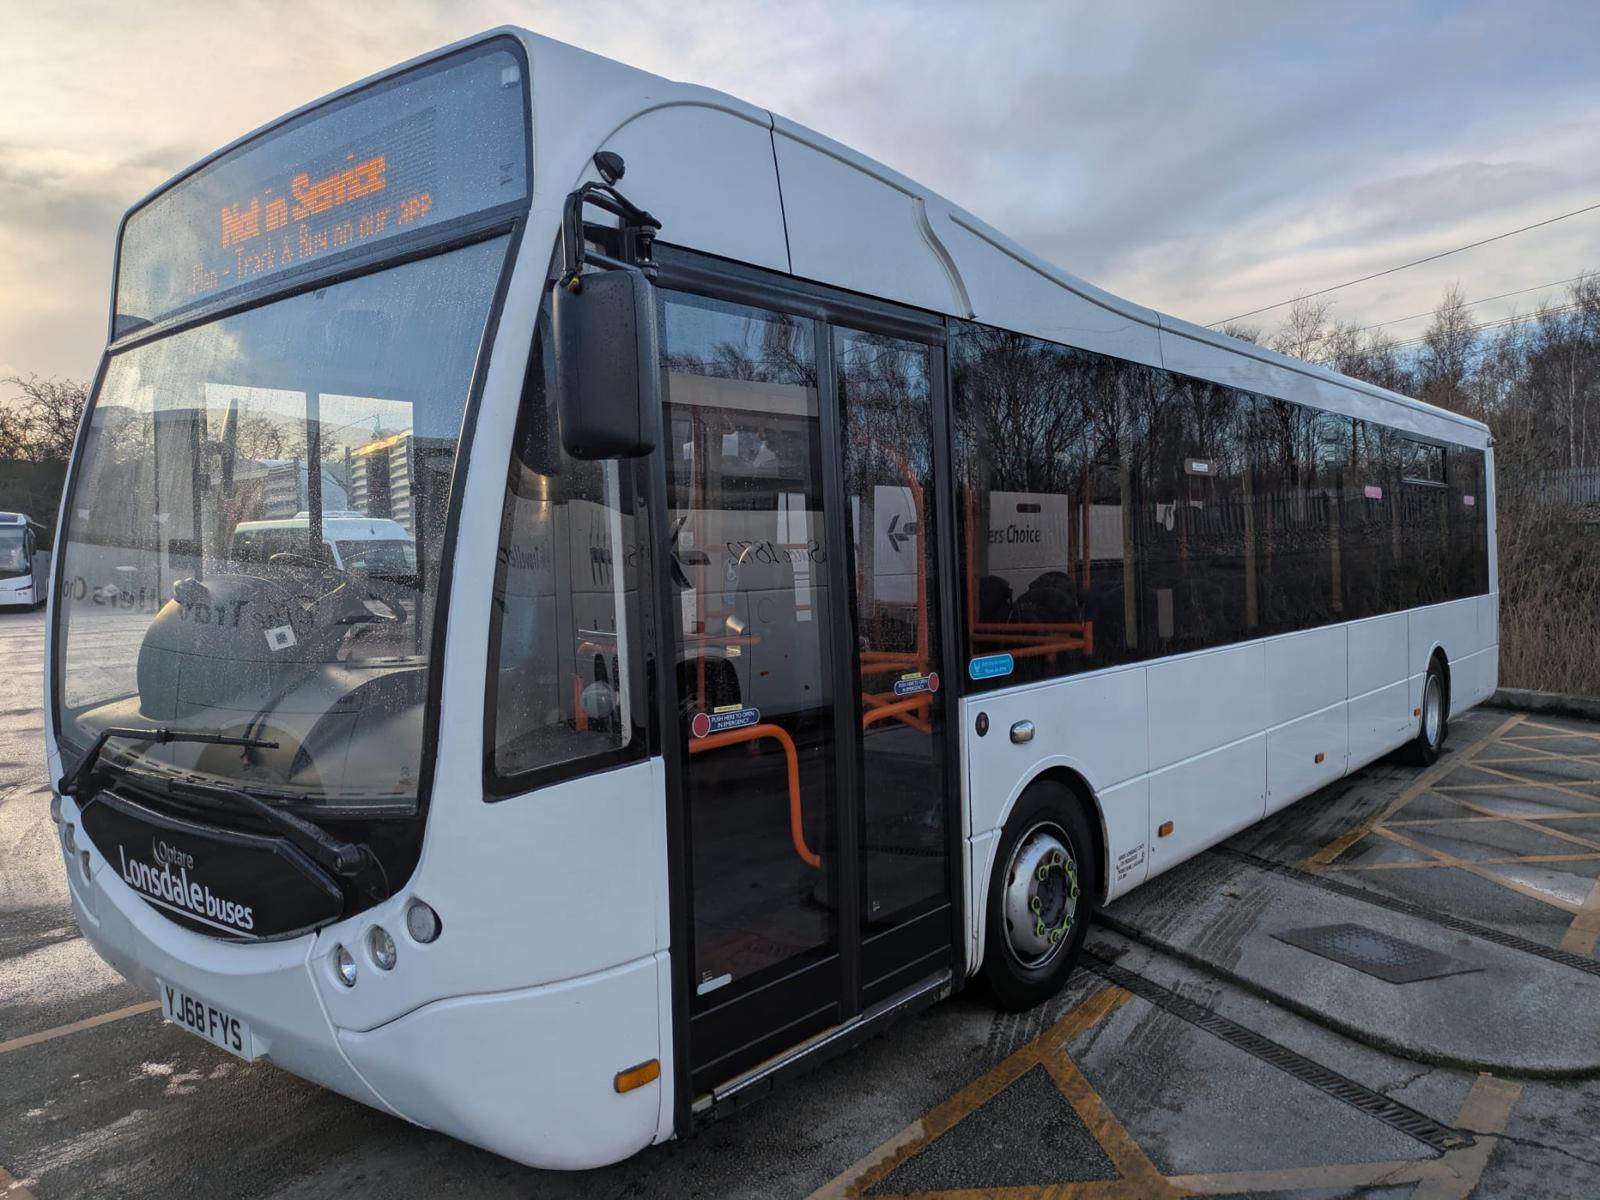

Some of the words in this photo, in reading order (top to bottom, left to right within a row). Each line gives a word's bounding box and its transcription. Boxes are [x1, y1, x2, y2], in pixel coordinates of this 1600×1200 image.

[265, 188, 288, 232] in
[291, 153, 386, 221] Service
[333, 223, 354, 247] on
[398, 193, 433, 226] app
[1007, 524, 1041, 544] Choice
[159, 840, 194, 870] Optare
[165, 984, 206, 1034] YJ68
[208, 1006, 243, 1052] FYS
